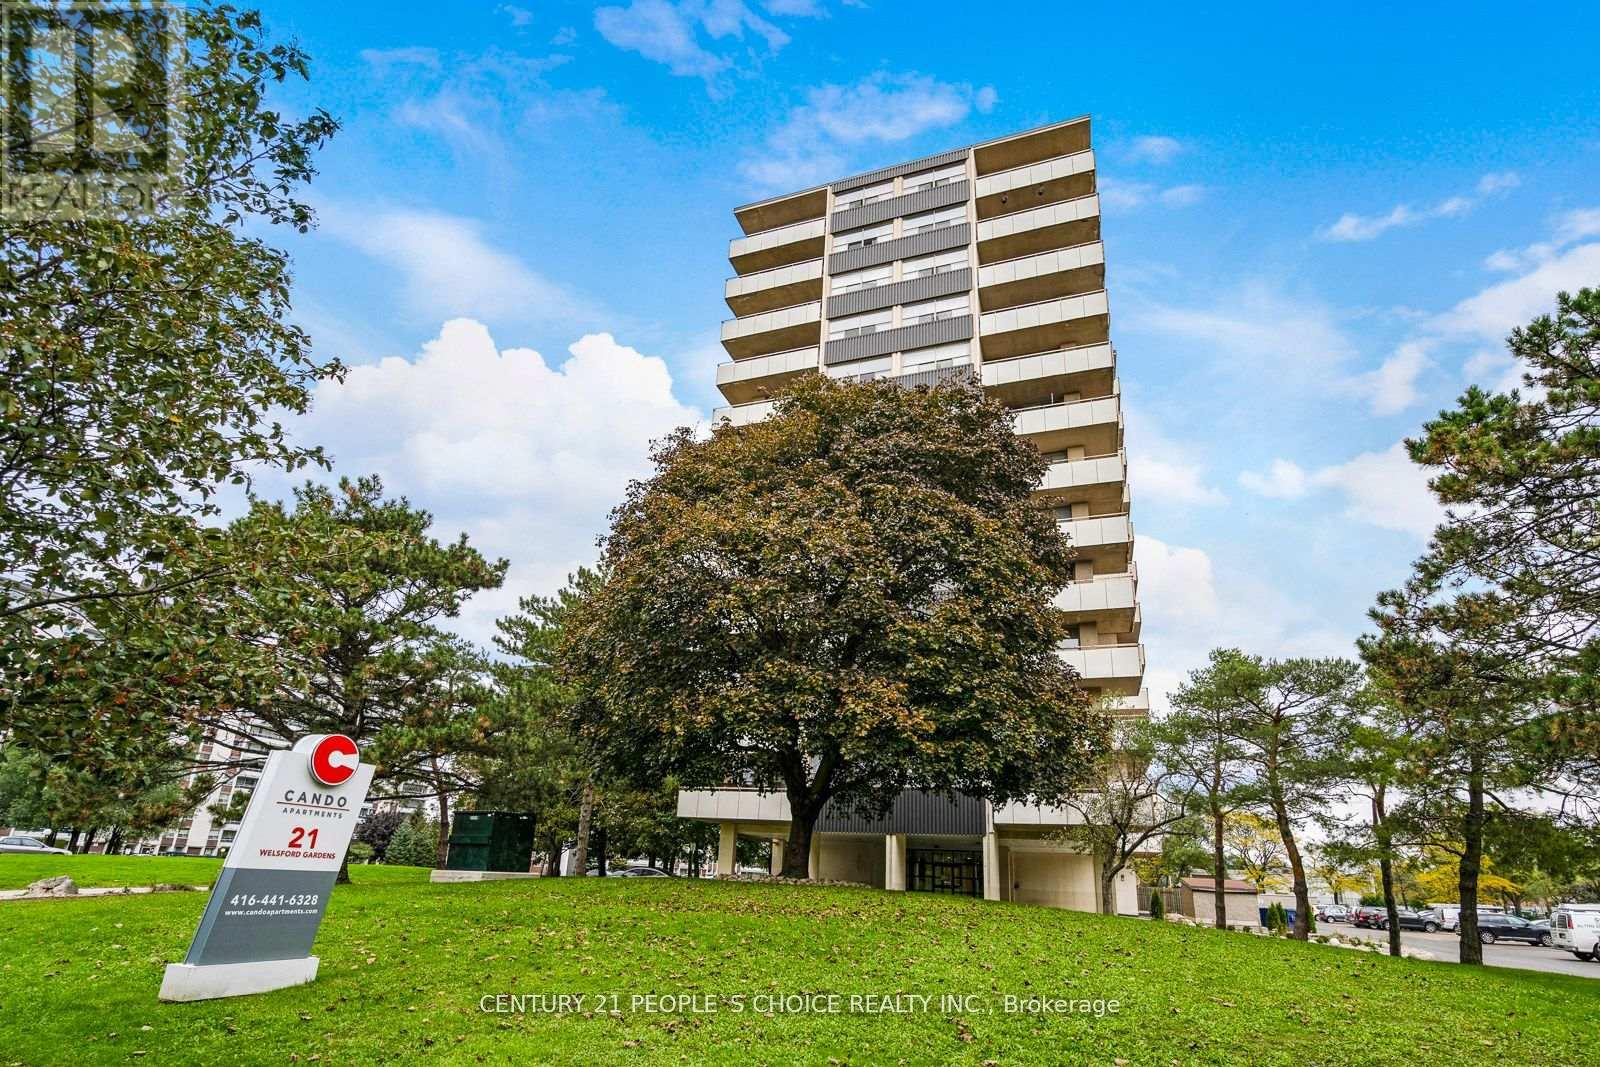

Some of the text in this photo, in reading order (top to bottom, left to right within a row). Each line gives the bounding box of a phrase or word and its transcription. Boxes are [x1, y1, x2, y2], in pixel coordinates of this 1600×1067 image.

[311, 734, 359, 785] C
[284, 790, 347, 807] CANDO
[282, 807, 343, 819] APARTMENTS
[288, 827, 319, 849] 21
[259, 849, 336, 860] WELSFORD GARDENS
[230, 894, 319, 906] 416-441-6328
